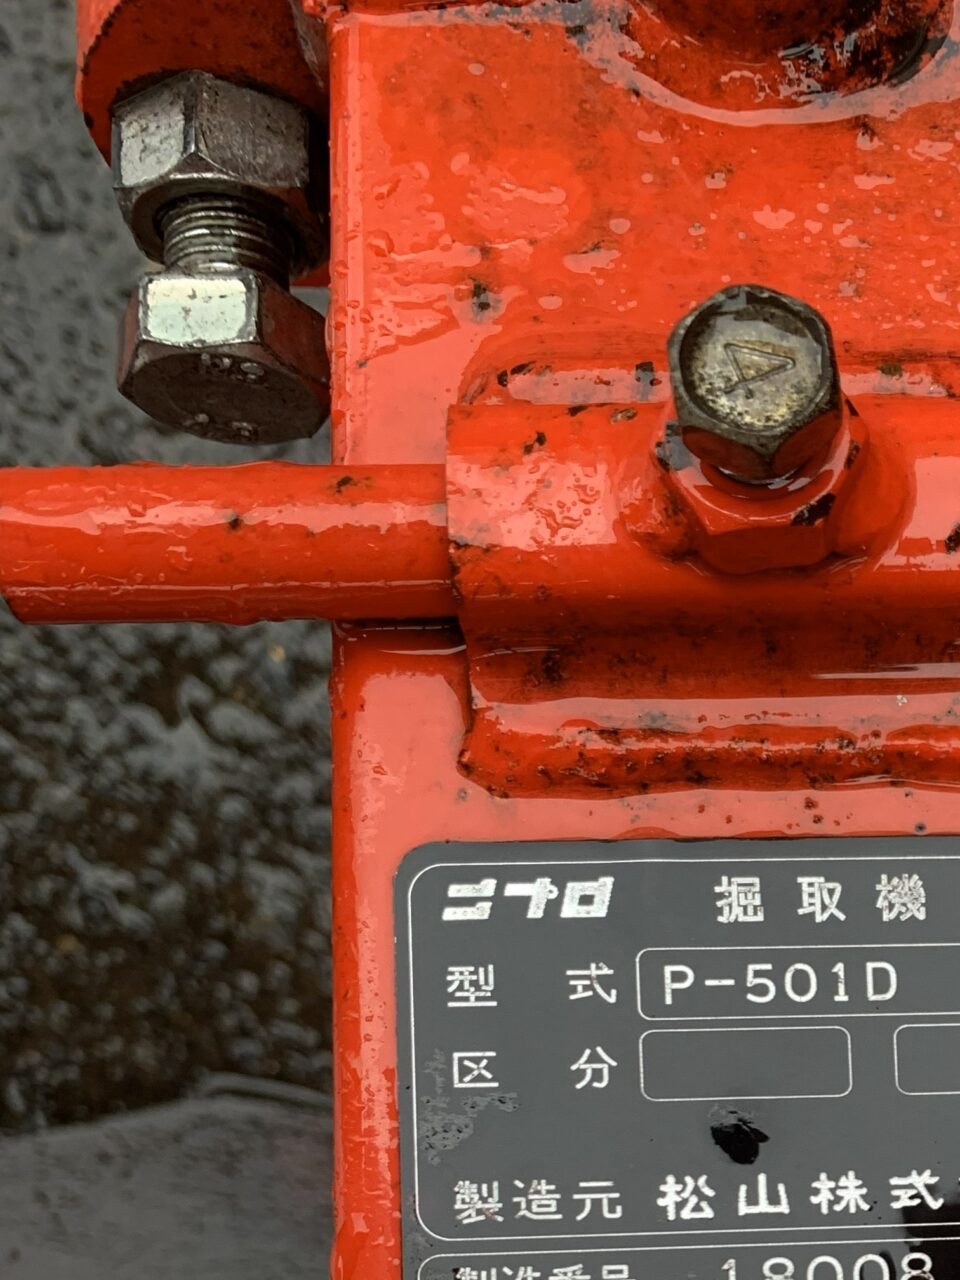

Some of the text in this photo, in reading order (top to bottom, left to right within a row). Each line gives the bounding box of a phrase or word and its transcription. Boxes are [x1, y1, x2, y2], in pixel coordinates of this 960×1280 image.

[442, 876, 615, 921] ニプロ
[714, 874, 927, 923] 掘取機
[664, 962, 898, 1004] P-501D
[453, 1179, 623, 1224] 製造元
